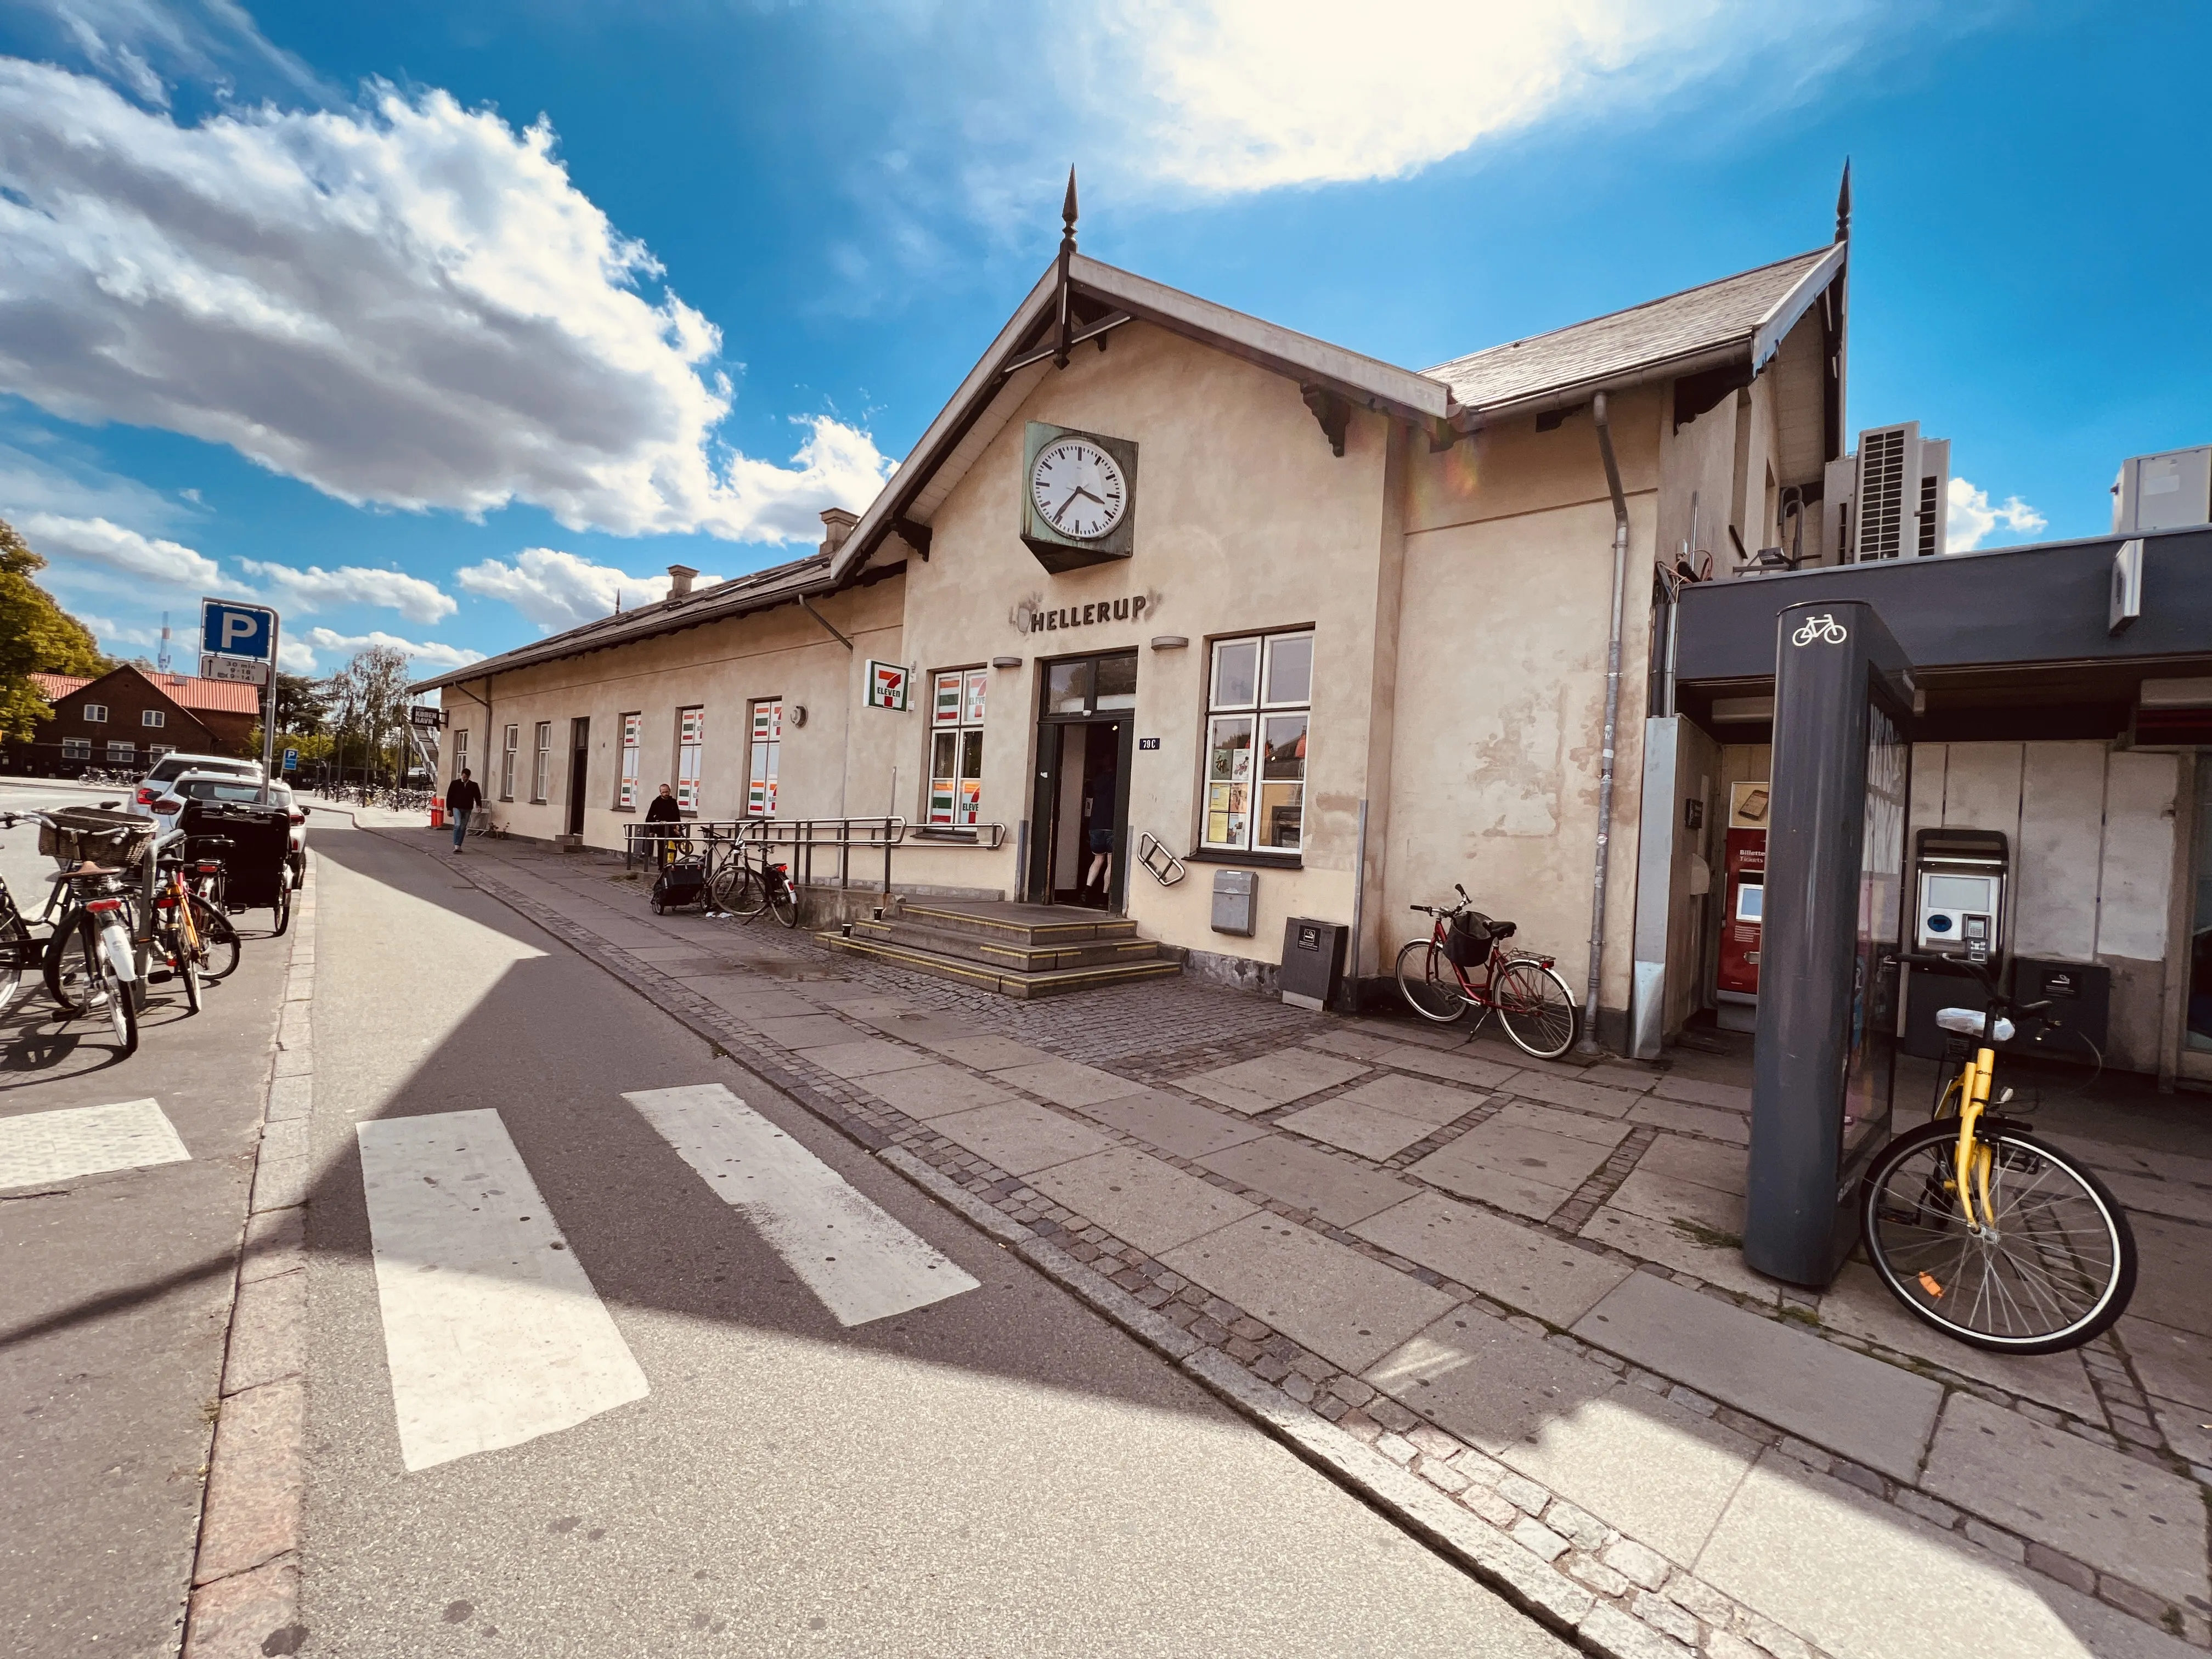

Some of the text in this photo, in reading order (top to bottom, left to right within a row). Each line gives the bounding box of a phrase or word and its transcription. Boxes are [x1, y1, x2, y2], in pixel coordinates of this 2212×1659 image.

[1031, 596, 1146, 633] HELLERUP
[222, 612, 258, 648] P
[969, 697, 985, 705] ELEVE
[415, 716, 433, 725] HAVN
[1143, 739, 1156, 749] 79 C
[962, 803, 979, 811] ELEVE
